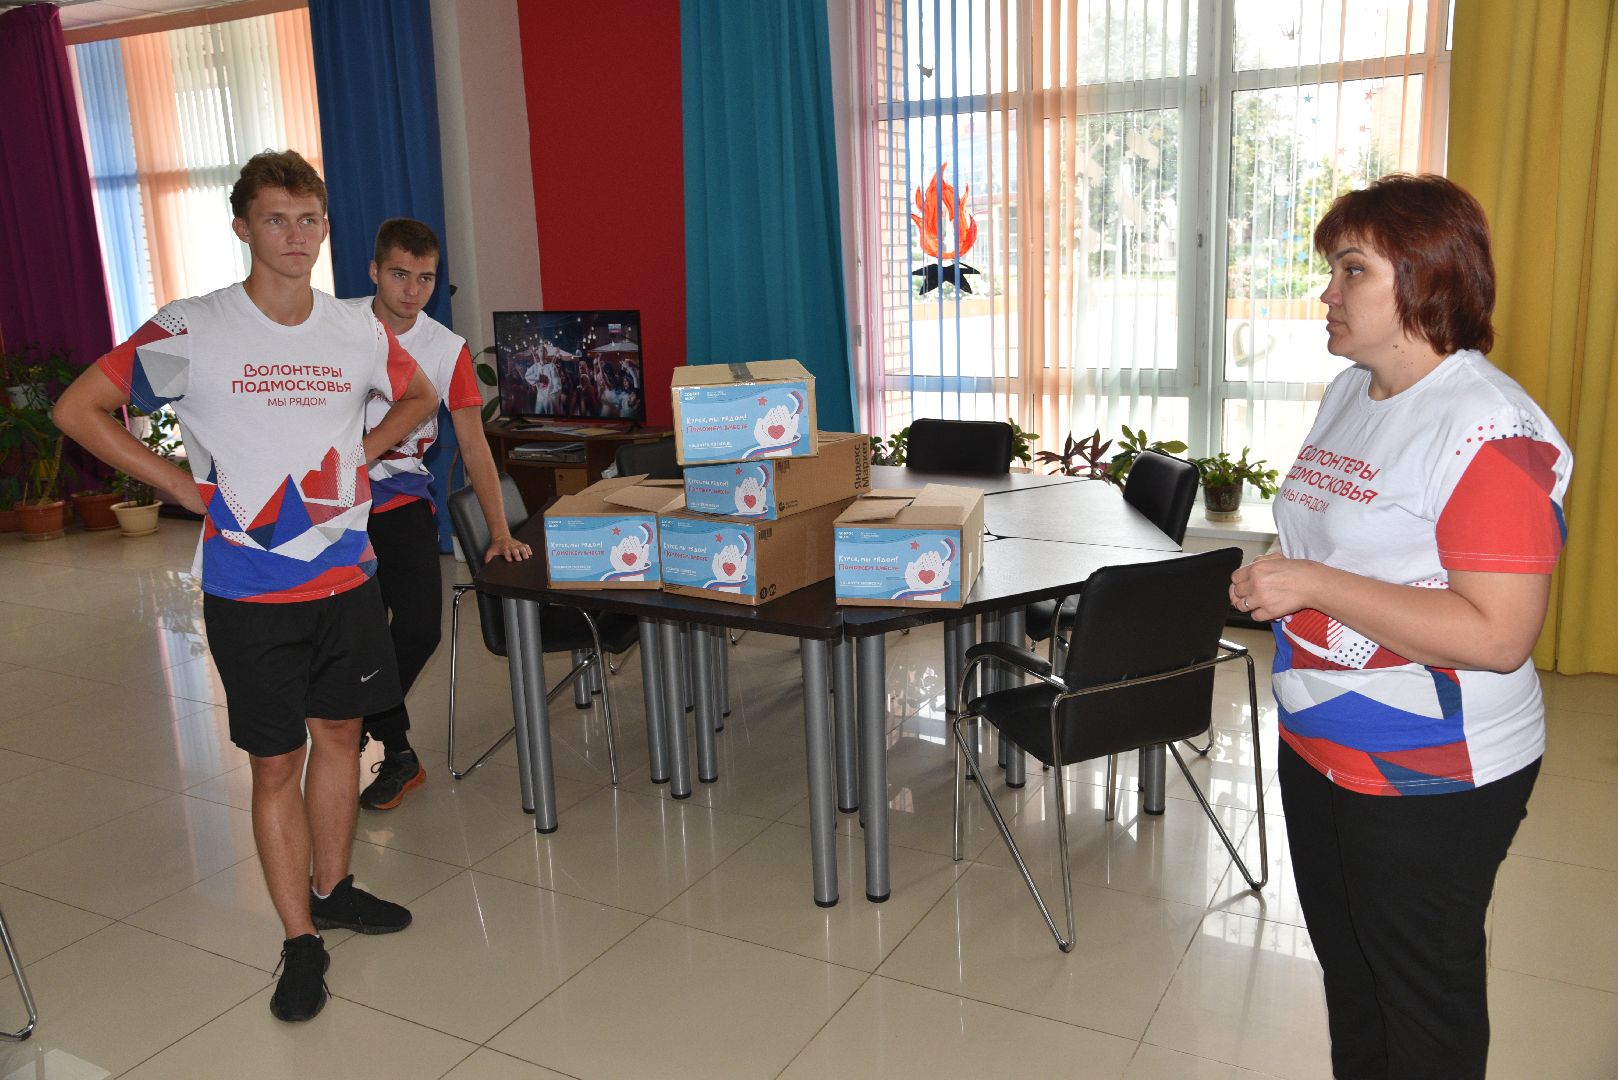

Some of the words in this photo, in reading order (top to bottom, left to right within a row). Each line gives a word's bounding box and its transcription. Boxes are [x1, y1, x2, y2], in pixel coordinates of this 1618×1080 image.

[244, 364, 343, 378] ВОЛОНТЕРЫ
[232, 380, 352, 393] ПОДМОСКОВЬЯ
[268, 398, 286, 406] МЫ
[289, 398, 326, 407] РЯДОМ
[862, 442, 870, 488] Маркет
[1281, 488, 1299, 502] МЫ
[1299, 494, 1330, 514] РЯДОМ
